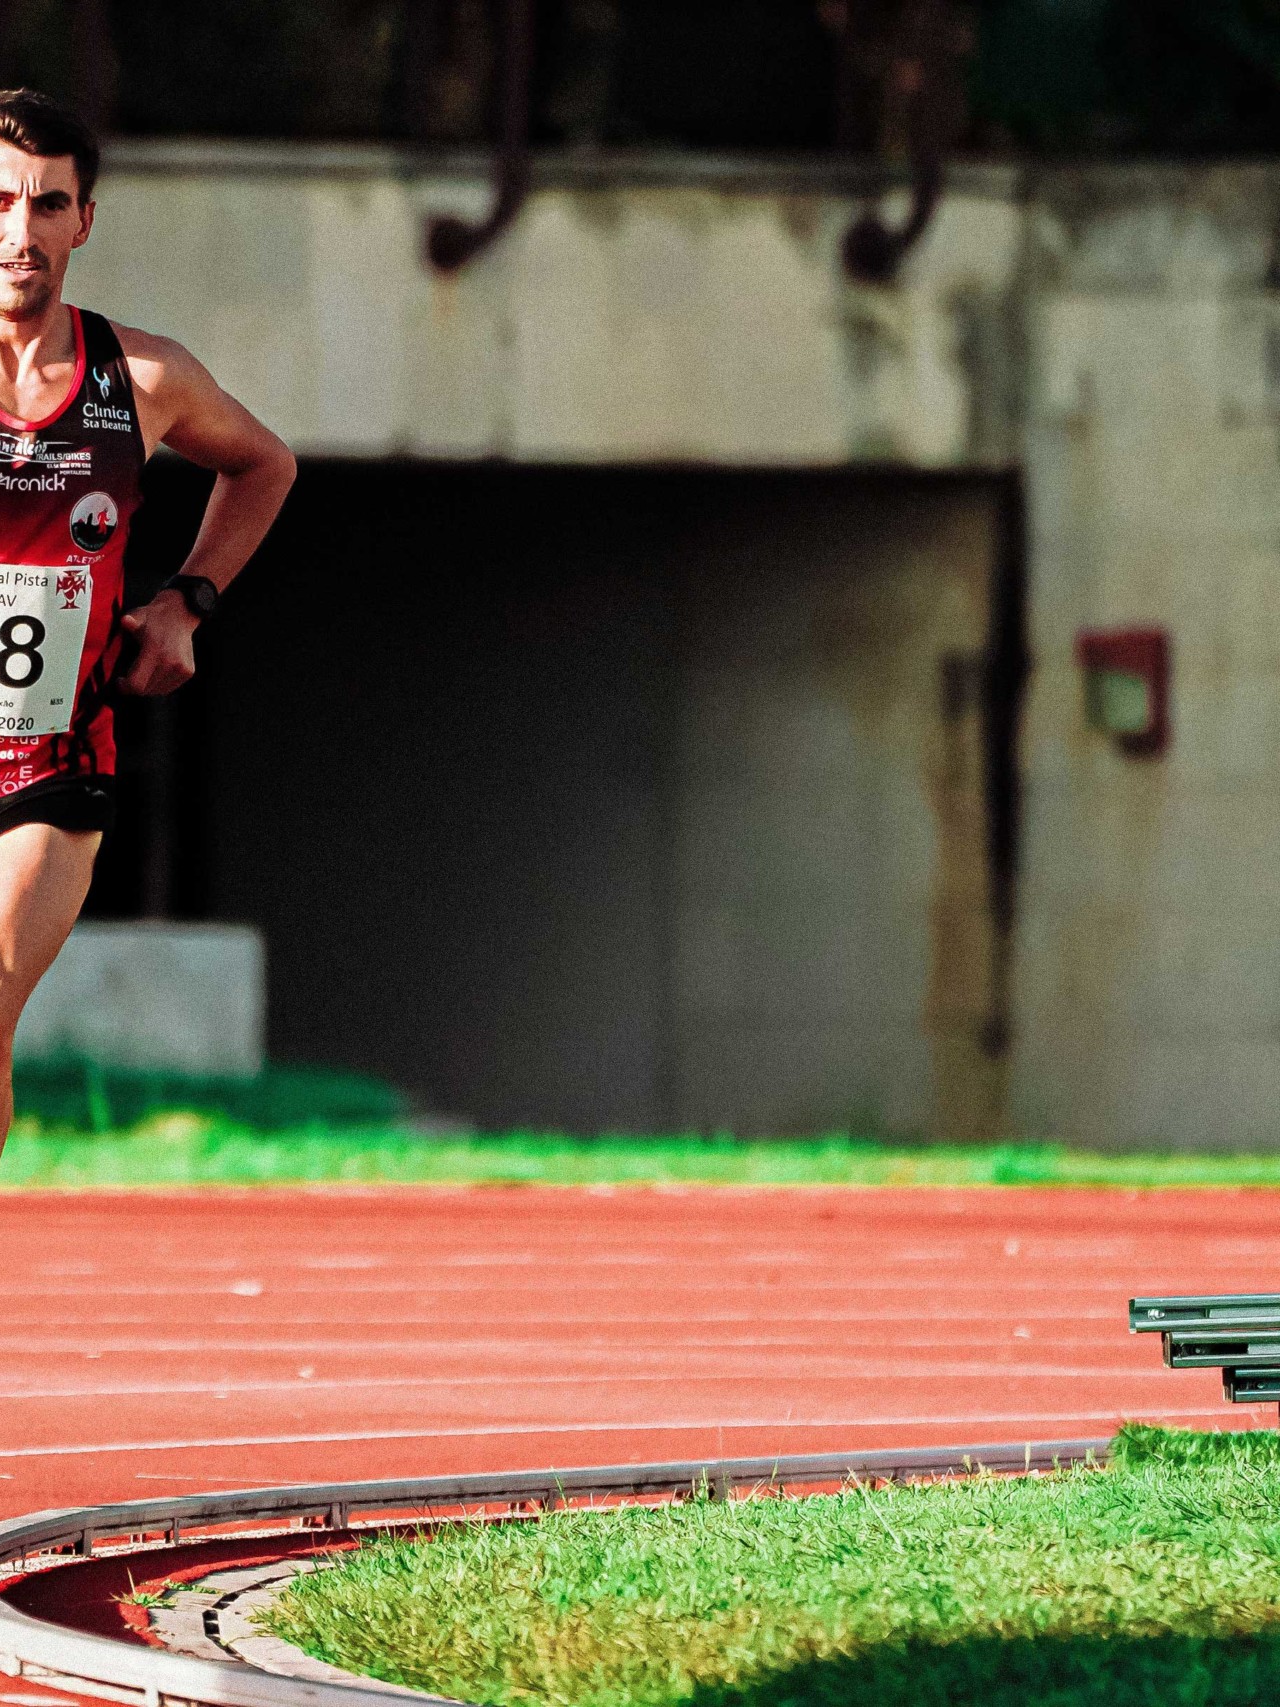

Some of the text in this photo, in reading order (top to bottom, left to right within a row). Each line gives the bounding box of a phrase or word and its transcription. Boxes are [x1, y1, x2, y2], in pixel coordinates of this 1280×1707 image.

[83, 418, 131, 432] Sta Beatriz
[14, 572, 49, 587] Pista
